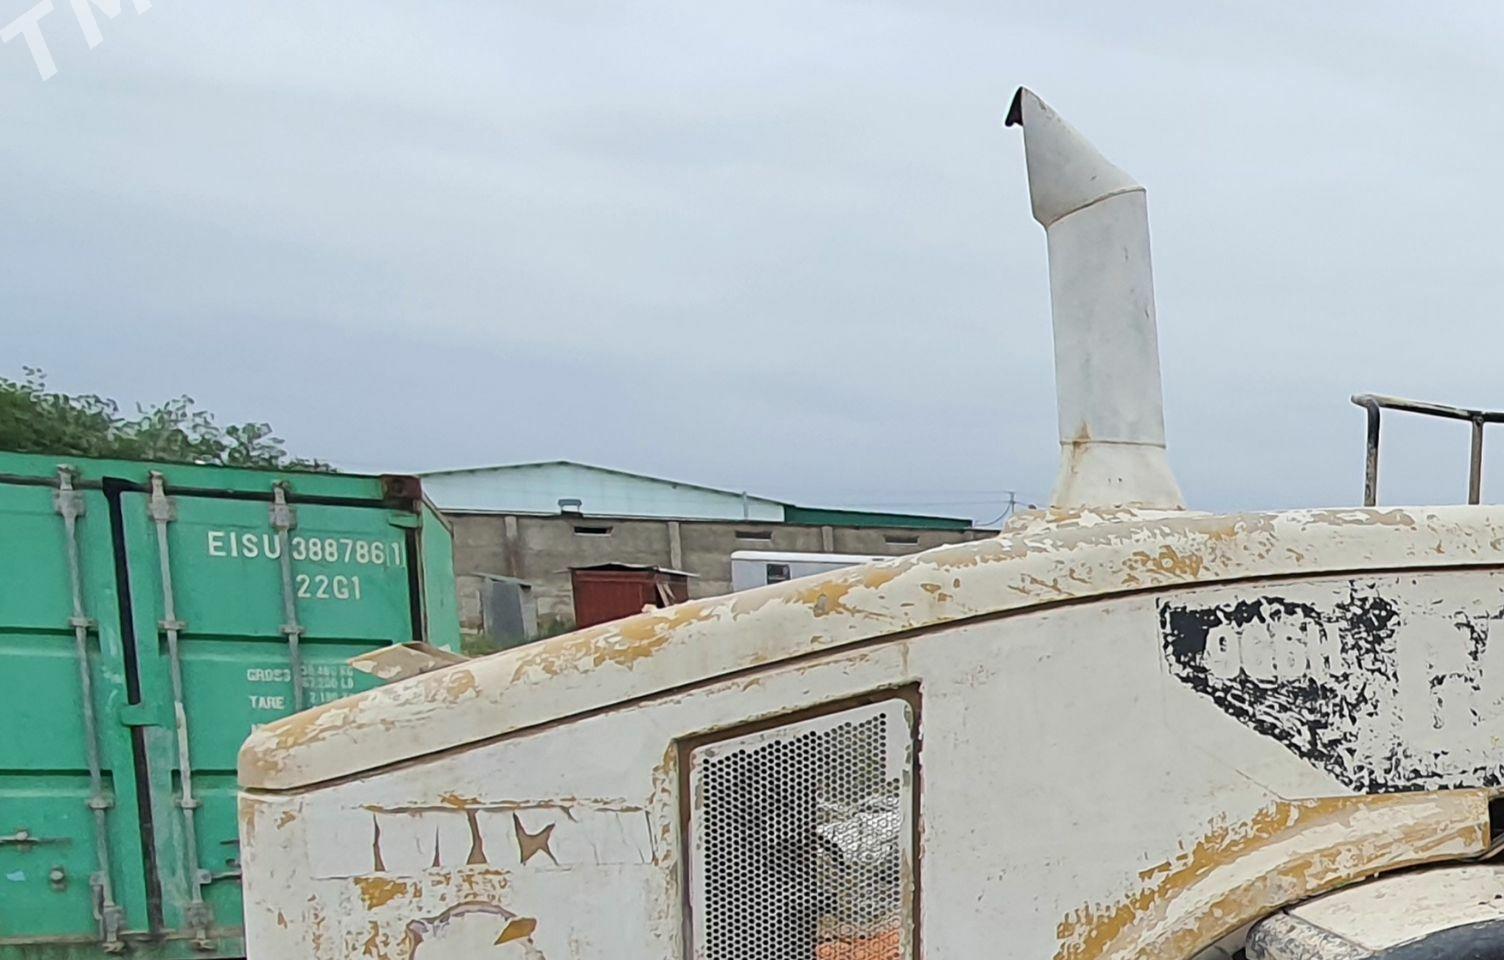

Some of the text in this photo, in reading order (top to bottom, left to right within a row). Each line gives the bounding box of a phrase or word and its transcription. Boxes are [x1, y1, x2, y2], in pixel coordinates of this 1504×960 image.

[207, 531, 281, 559] EISU
[296, 574, 361, 600] 22G1
[248, 695, 285, 710] TARE
